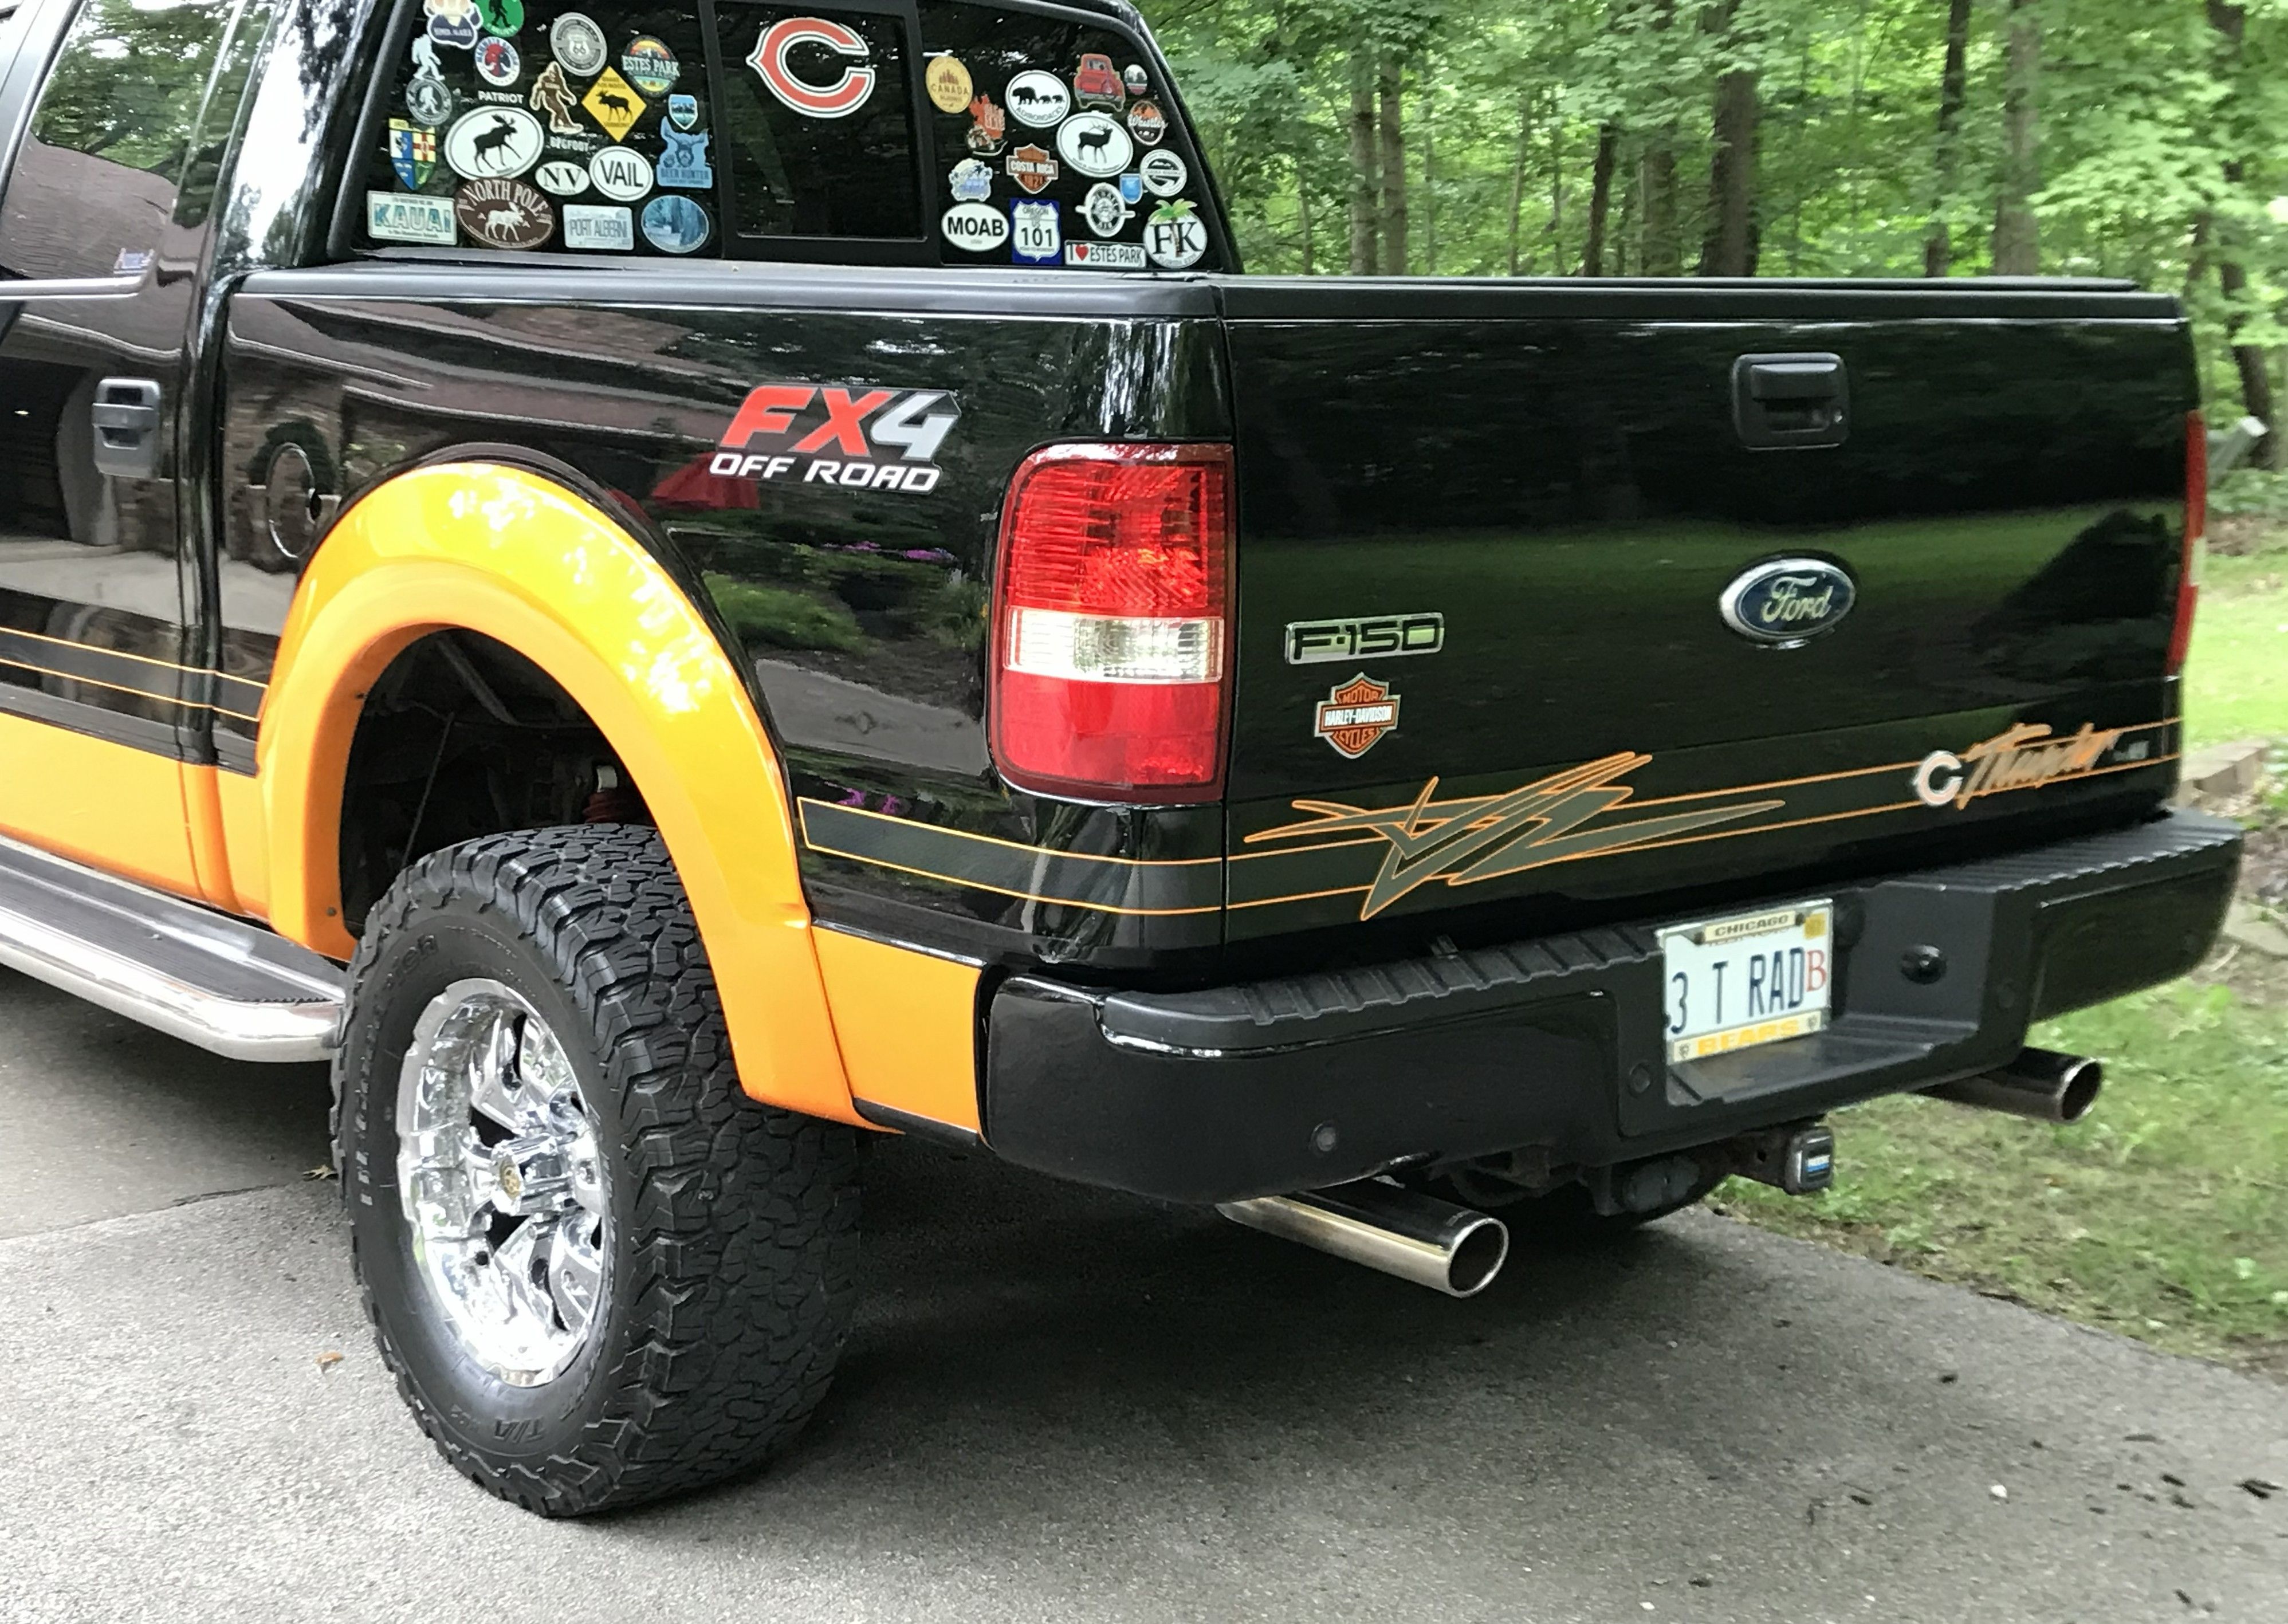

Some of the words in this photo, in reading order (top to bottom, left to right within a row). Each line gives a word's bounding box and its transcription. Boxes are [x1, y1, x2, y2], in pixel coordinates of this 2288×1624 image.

[622, 55, 651, 71] ESTES
[653, 60, 680, 77] PARK
[746, 17, 875, 118] C
[478, 91, 524, 104] PATRIOT
[931, 84, 968, 95] CANADA
[551, 136, 589, 152] BIGFOOT
[600, 159, 643, 188] VAIL
[1011, 160, 1034, 171] COSTA
[543, 166, 581, 188] NV
[463, 179, 511, 205] NORTH
[513, 183, 549, 217] POLE
[374, 202, 451, 233] KAUAI
[569, 218, 592, 236] PORT
[948, 216, 1004, 237] MOAB
[1021, 227, 1052, 247] 101
[1091, 245, 1116, 262] ESTES
[1119, 246, 1142, 263] PARK
[719, 385, 960, 461] FX4
[710, 453, 796, 479] OFF
[803, 459, 942, 491] ROAD
[1761, 576, 1833, 623] Ford
[1343, 687, 1379, 704] MOTOR
[1324, 705, 1393, 726] HARLEY-DAVIDSON
[1339, 728, 1376, 747] CYCLES
[1715, 914, 1790, 937] CHICAGO
[1697, 1019, 1799, 1055] BEARS
